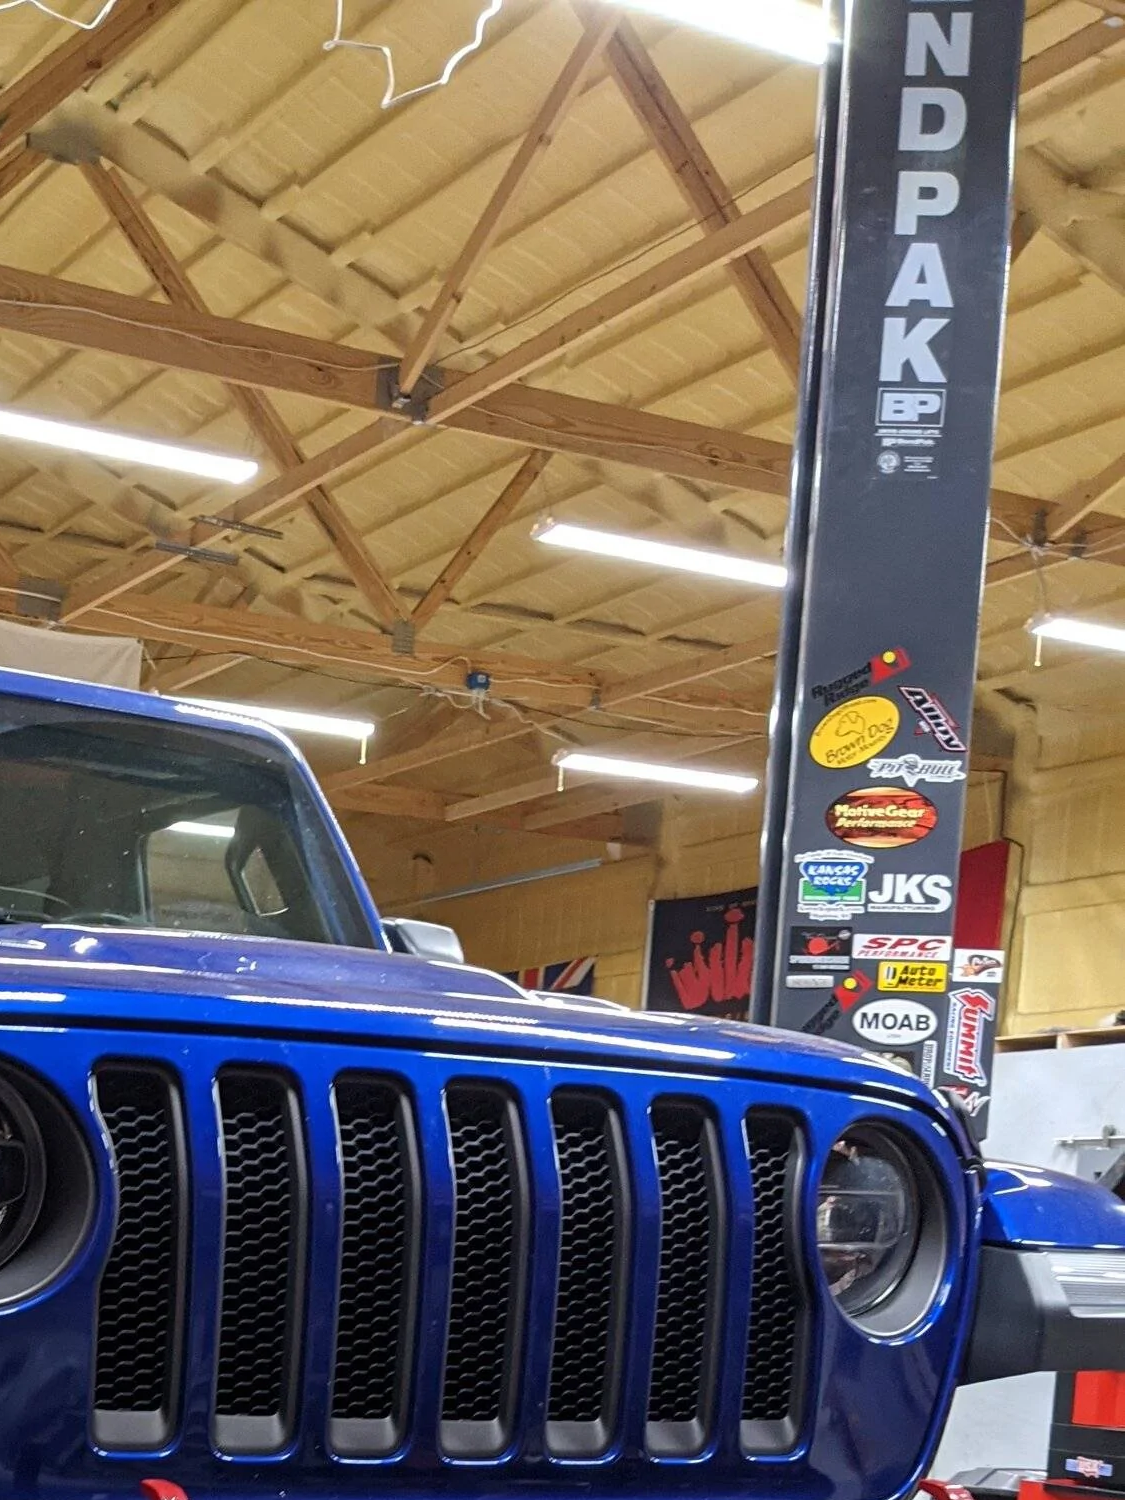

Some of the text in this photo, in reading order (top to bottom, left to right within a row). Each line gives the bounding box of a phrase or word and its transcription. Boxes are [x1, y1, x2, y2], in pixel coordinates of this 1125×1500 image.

[878, 0, 974, 383] NDPAK
[880, 392, 941, 421] BP
[825, 734, 866, 763] Brown
[867, 718, 894, 739] Dog
[835, 817, 917, 828] Performance
[807, 865, 860, 876] KANSAS
[868, 873, 952, 912] JKS
[862, 937, 946, 951] SPC
[857, 950, 939, 959] PERFORMANCE
[900, 965, 936, 976] Auto
[897, 976, 943, 987] Meter
[860, 1012, 931, 1031] MOAB
